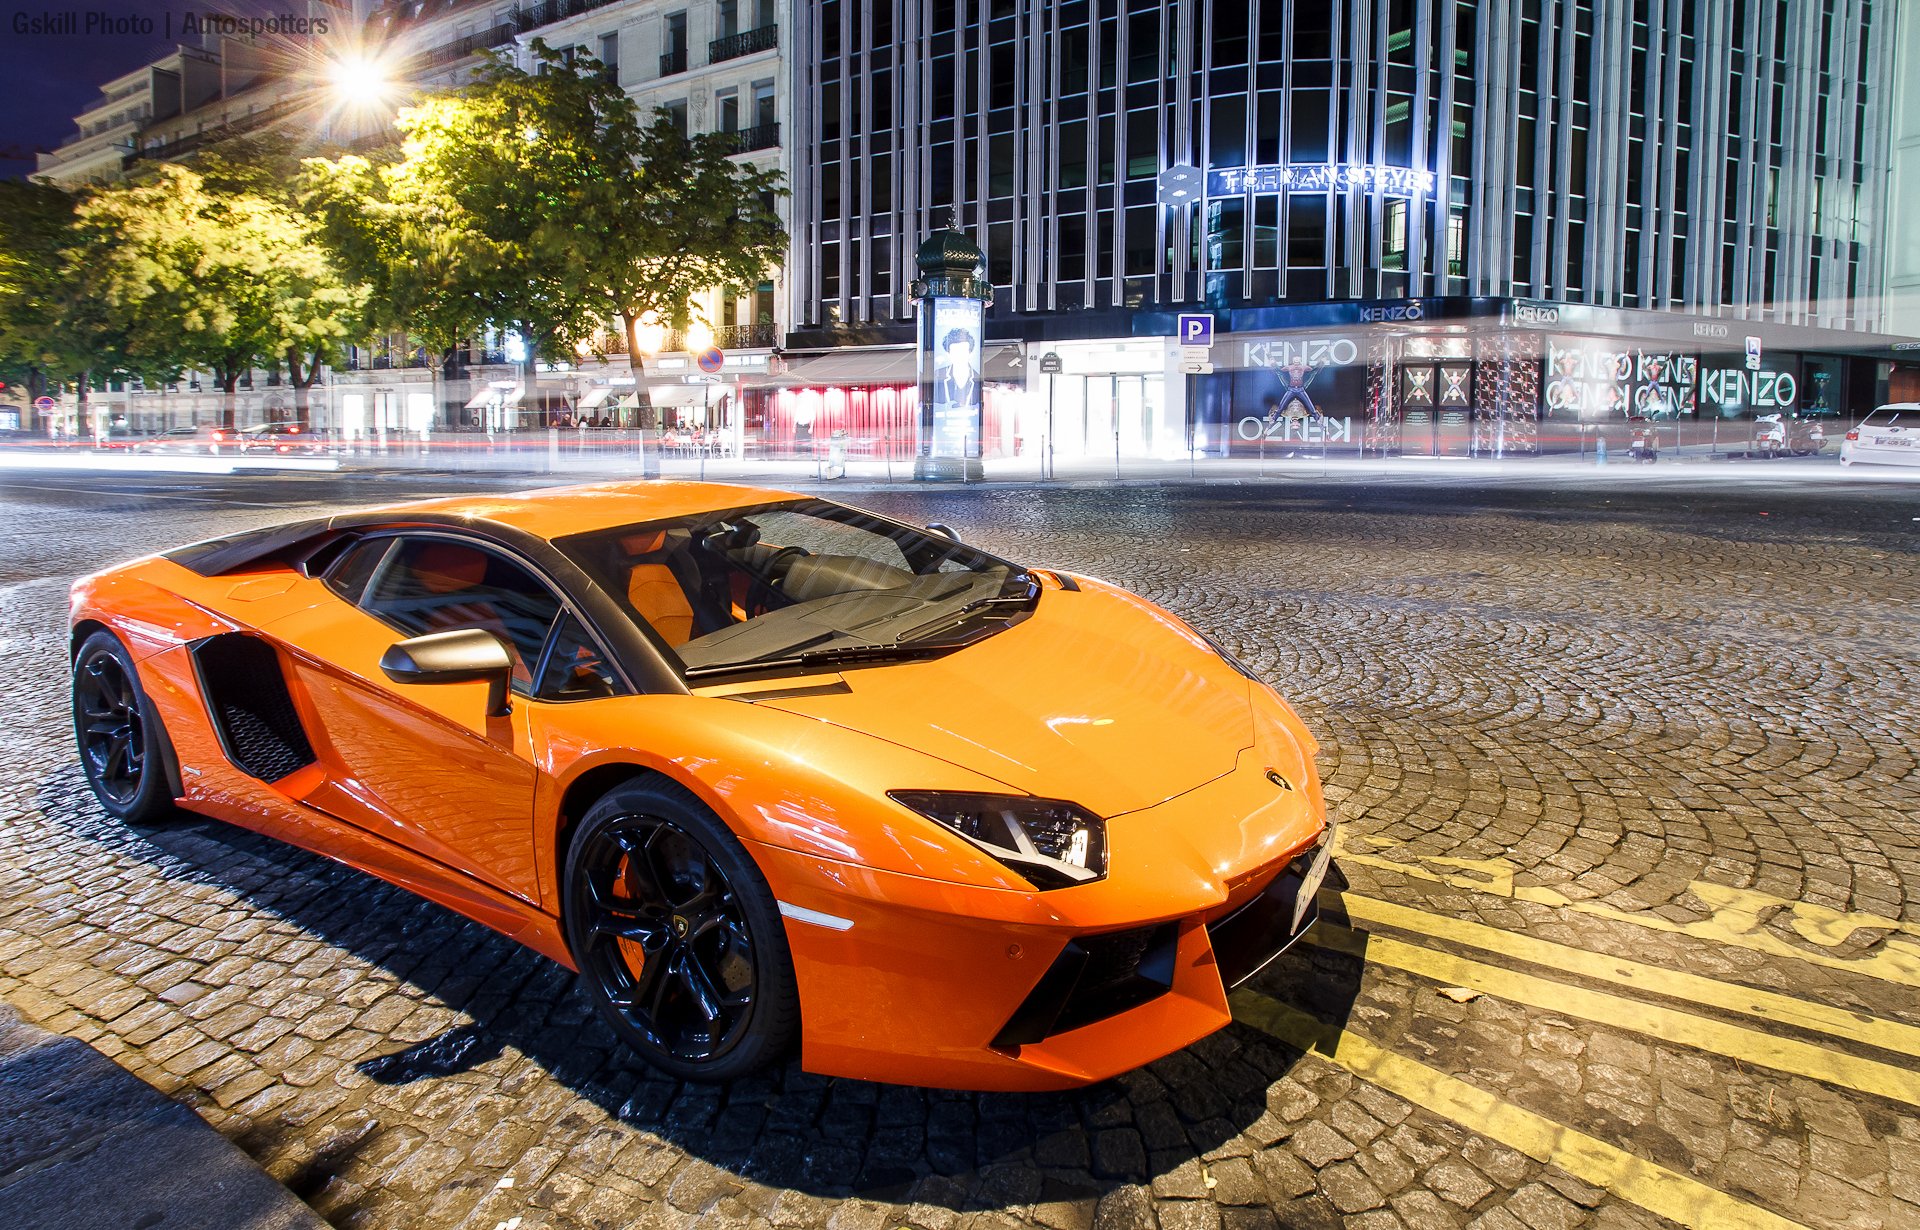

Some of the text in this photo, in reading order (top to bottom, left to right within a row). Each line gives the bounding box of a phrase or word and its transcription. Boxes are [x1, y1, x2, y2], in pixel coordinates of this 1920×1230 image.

[1219, 165, 1434, 193] TISHMAN SPEYER
[1360, 305, 1423, 322] KENZO
[1515, 305, 1559, 323] KENZO
[1188, 320, 1204, 341] P
[1693, 322, 1728, 337] KENZO
[1243, 339, 1358, 367] KENZO
[1700, 367, 1797, 407] KENZO
